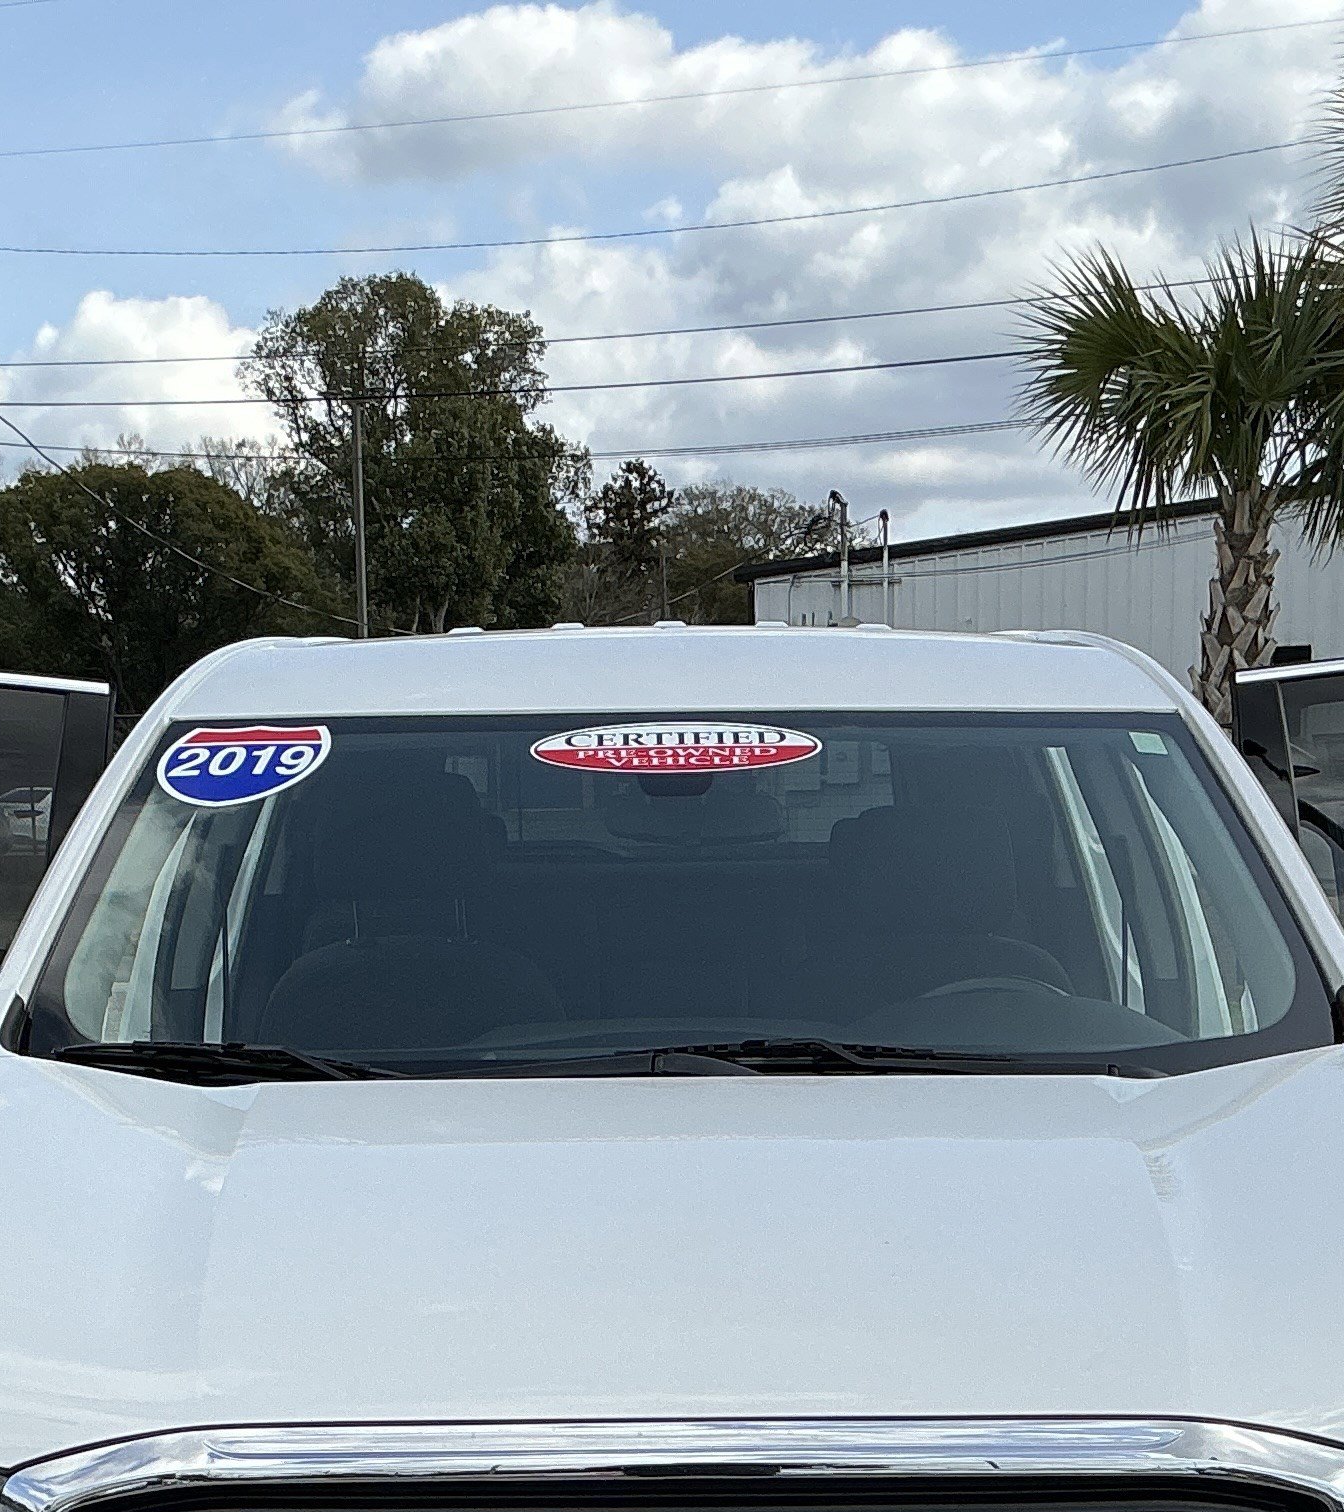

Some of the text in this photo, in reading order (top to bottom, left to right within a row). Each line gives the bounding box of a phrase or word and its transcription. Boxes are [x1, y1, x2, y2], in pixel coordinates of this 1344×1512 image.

[564, 729, 787, 748] CERTIFIED
[166, 745, 315, 777] 2019
[577, 746, 778, 760] PRE-OWNED
[606, 755, 751, 767] VEHICLE
